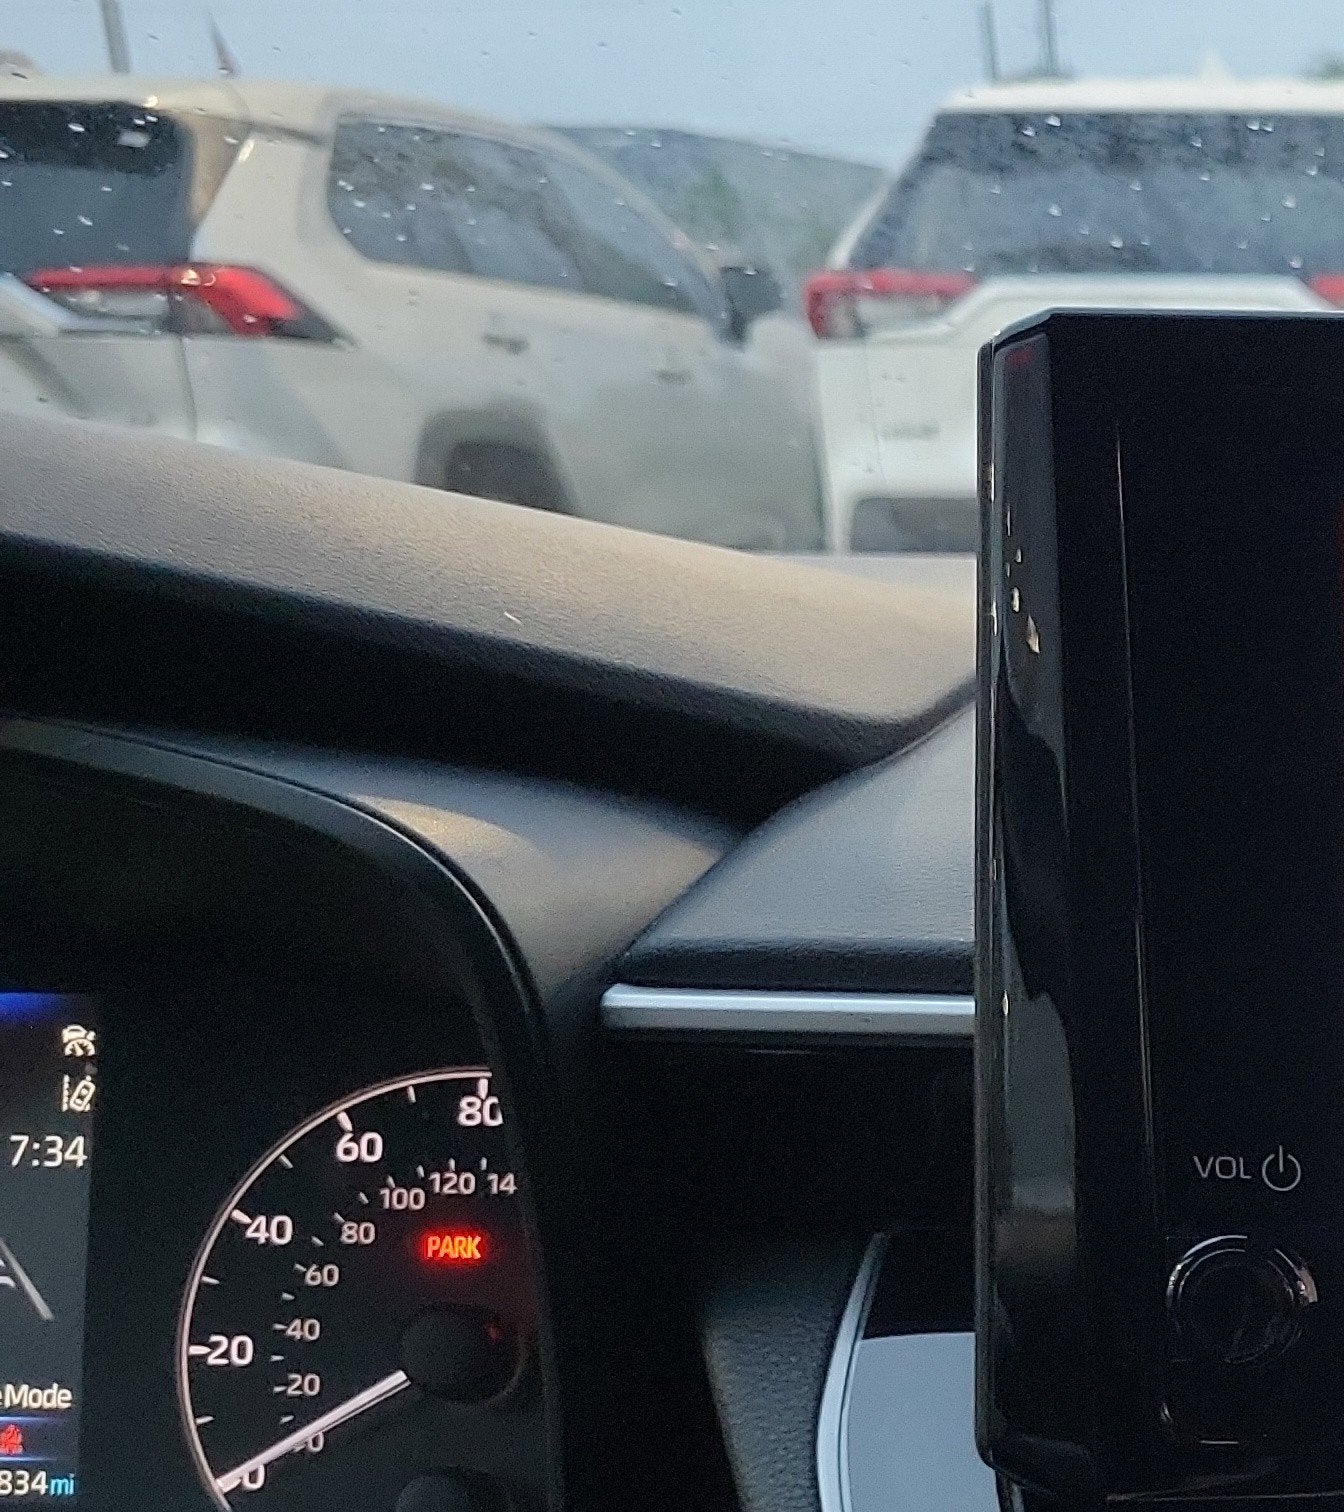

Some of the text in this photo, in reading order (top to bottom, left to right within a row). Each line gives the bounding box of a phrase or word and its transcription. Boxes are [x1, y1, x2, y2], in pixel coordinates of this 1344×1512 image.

[458, 1095, 503, 1126] 80
[9, 1134, 88, 1168] 7:34
[336, 1132, 383, 1163] 60
[1193, 1155, 1252, 1181] VOL
[429, 1172, 476, 1195] 120
[487, 1172, 518, 1195] 14
[379, 1187, 426, 1210] 100
[245, 1214, 293, 1246] 40
[340, 1221, 376, 1245] 80
[426, 1235, 482, 1259] PARK
[304, 1263, 340, 1287] 60
[285, 1318, 321, 1341] 40
[207, 1334, 254, 1367] 20
[4, 1382, 73, 1409] Mode
[286, 1373, 321, 1396] 20
[0, 1469, 75, 1496] 834 mi
